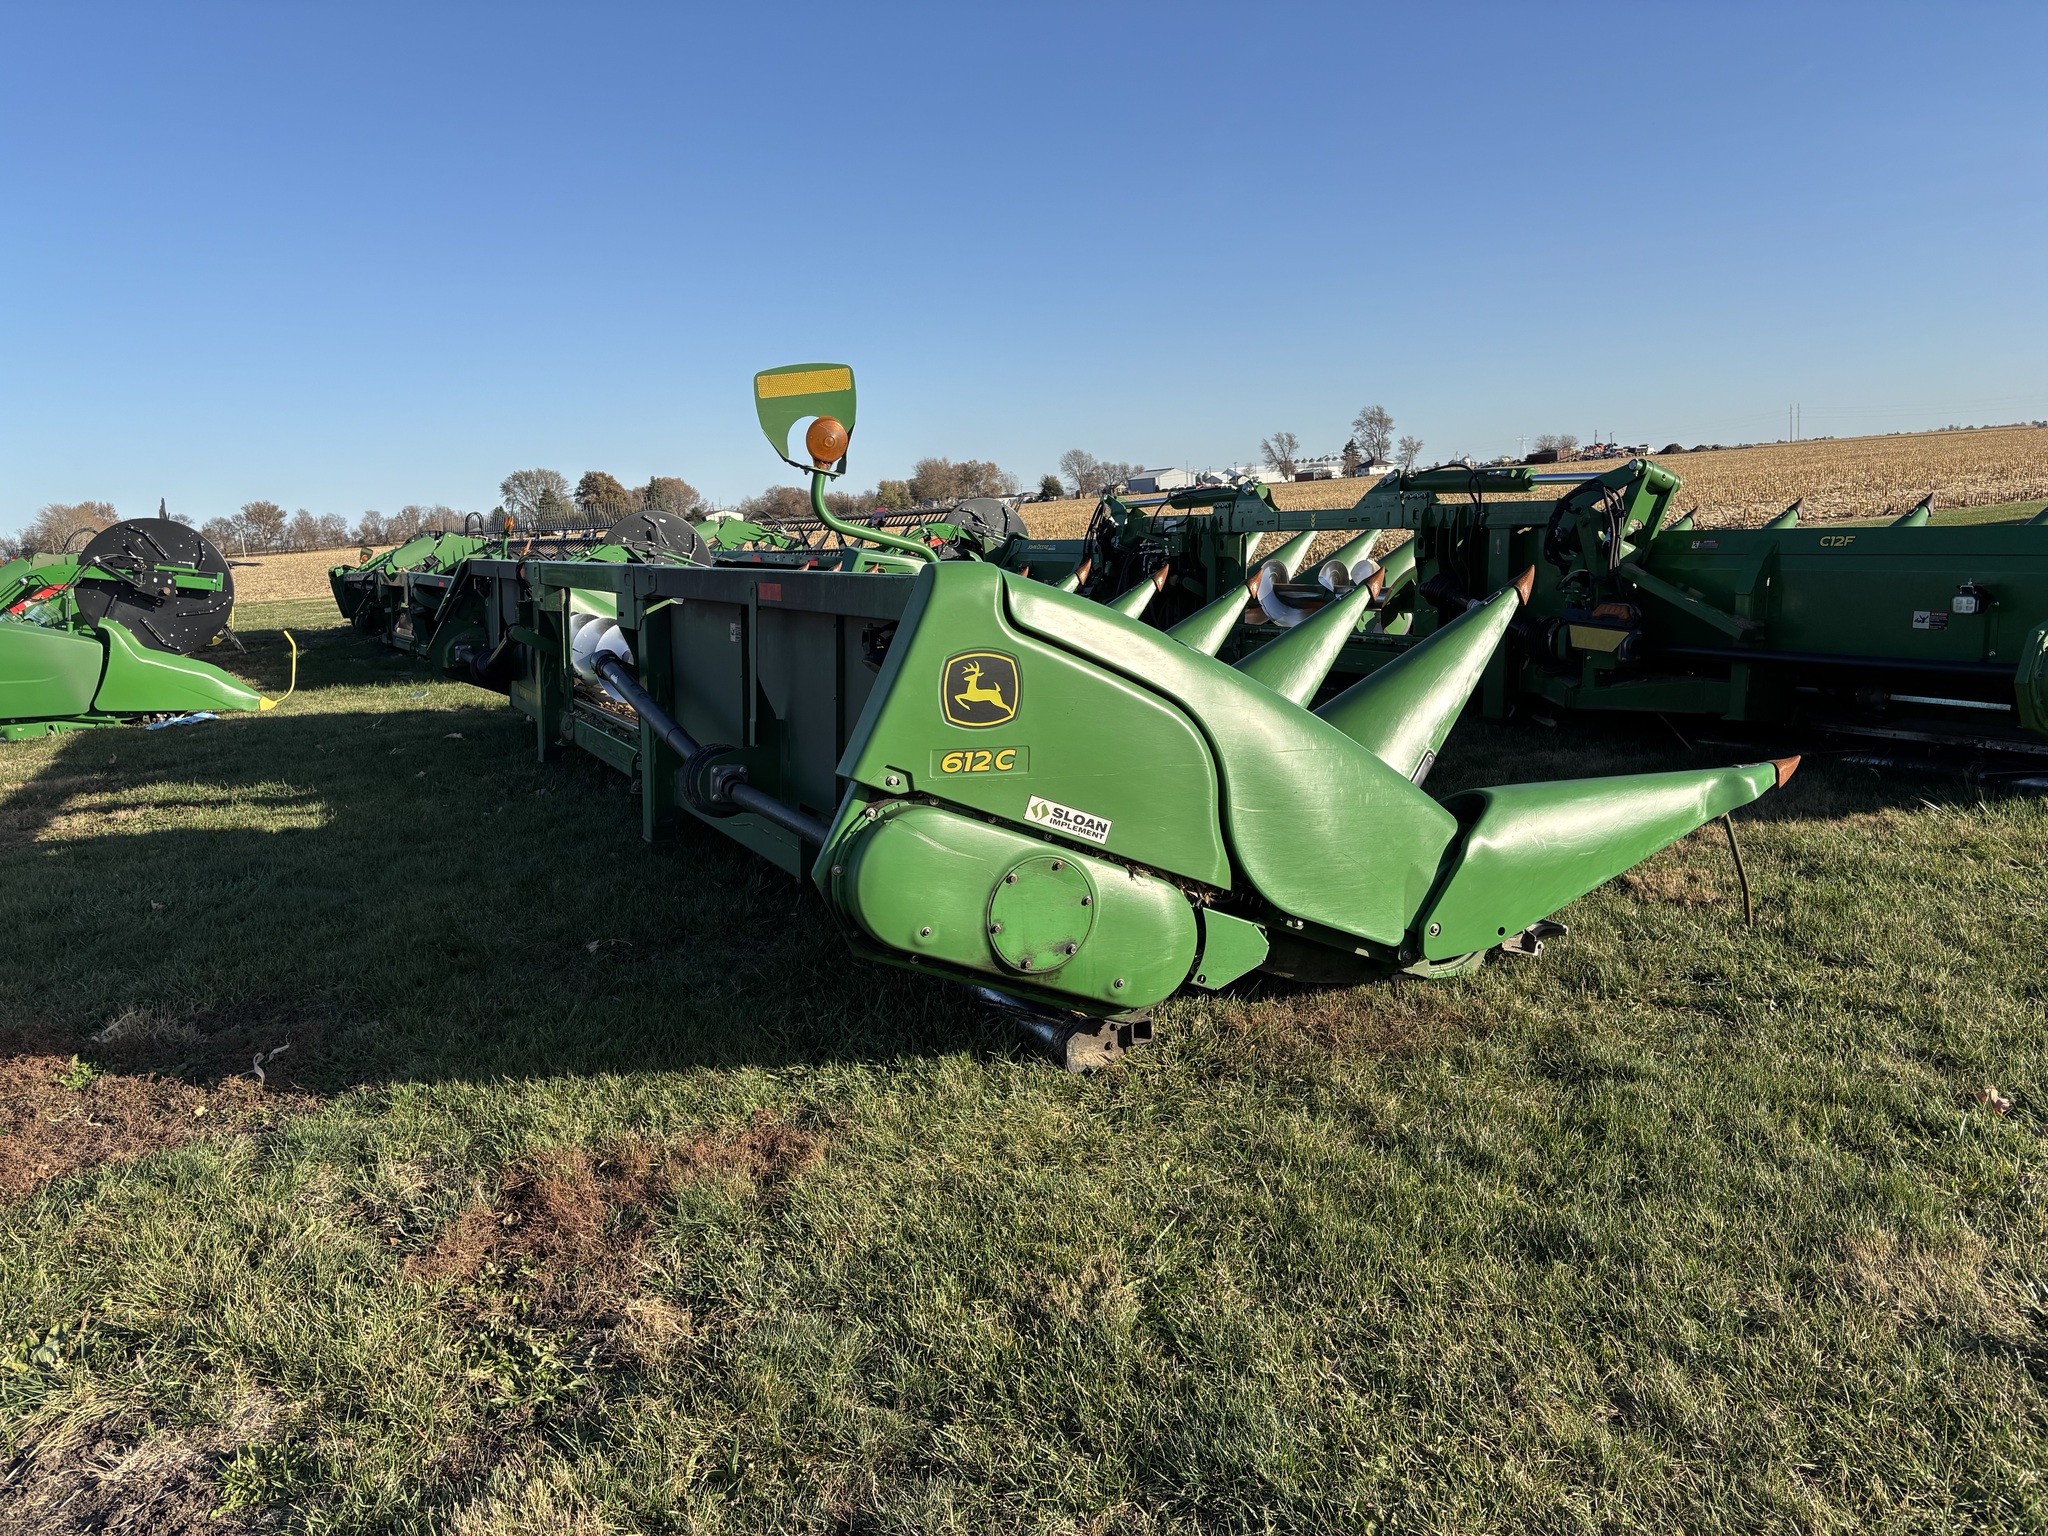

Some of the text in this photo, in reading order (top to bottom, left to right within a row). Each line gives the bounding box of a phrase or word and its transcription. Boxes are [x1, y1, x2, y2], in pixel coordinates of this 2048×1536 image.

[1819, 535, 1856, 547] C12F
[1049, 817, 1105, 840] IMPLEMENT
[1052, 807, 1108, 833] SLOAN
